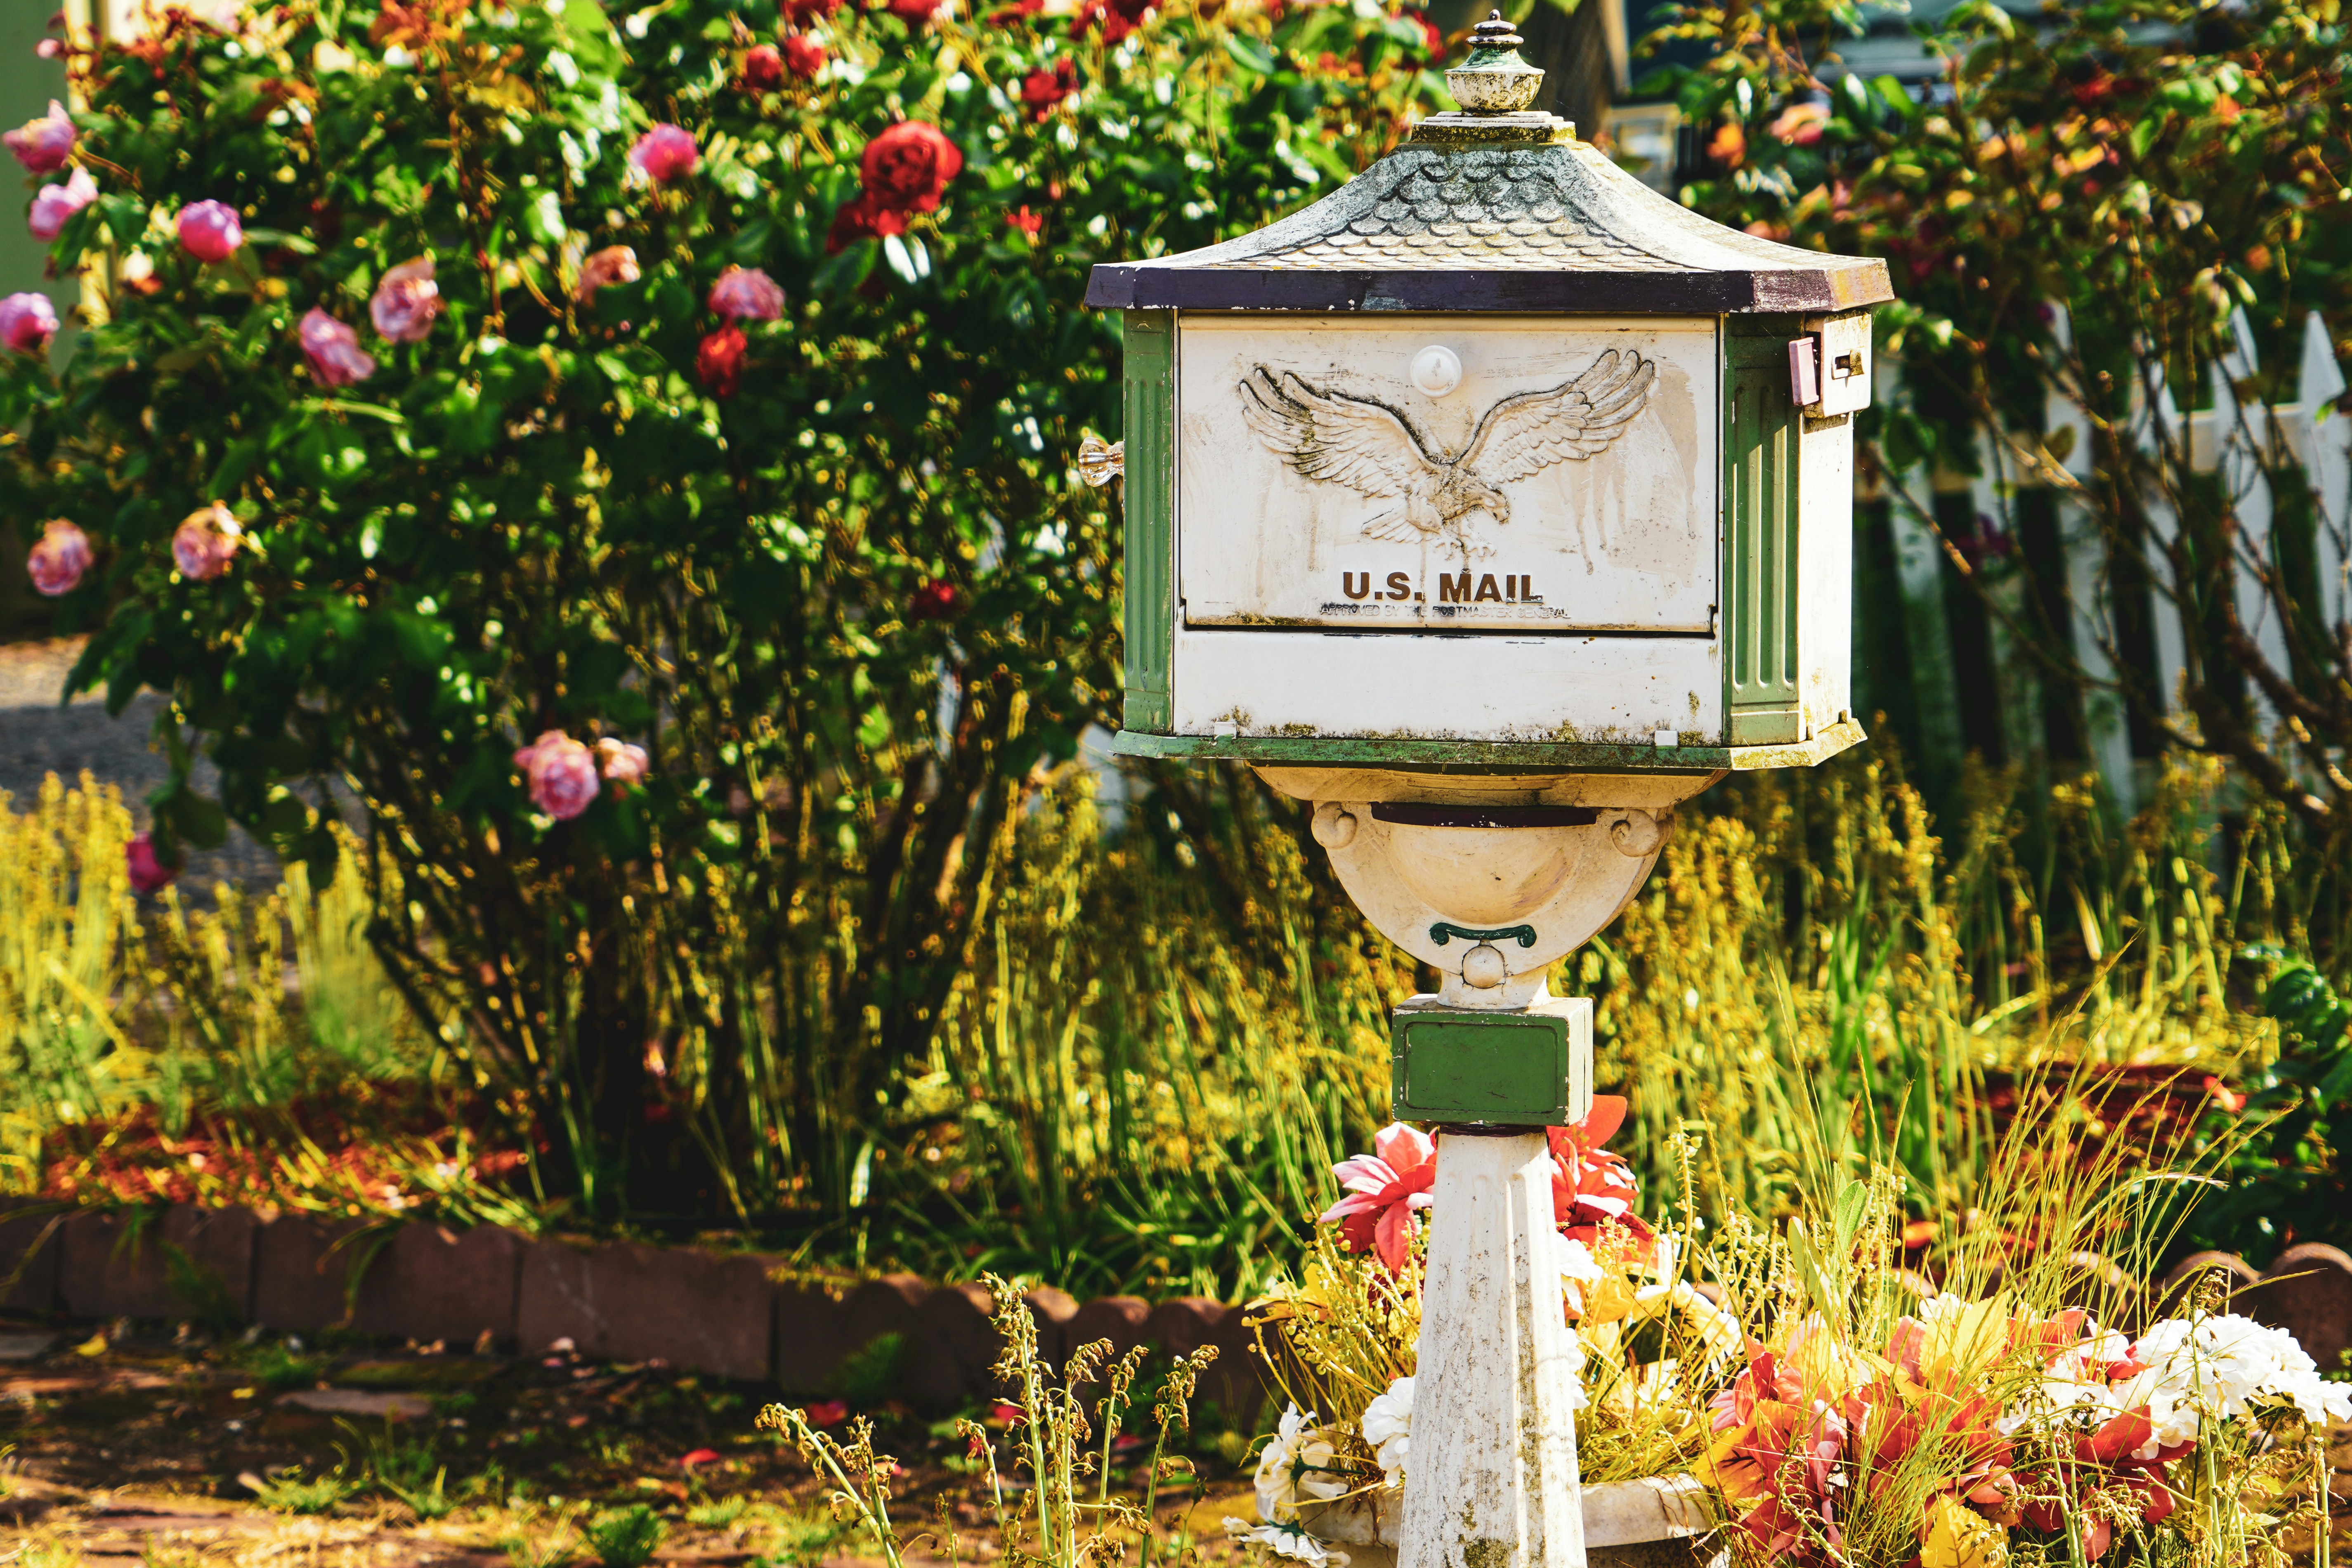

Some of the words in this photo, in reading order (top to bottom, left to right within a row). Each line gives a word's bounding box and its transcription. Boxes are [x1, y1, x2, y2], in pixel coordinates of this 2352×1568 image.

[1343, 572, 1423, 600] U.S.
[1439, 573, 1543, 604] MAIL
[1320, 604, 1380, 616] APPROVED
[1385, 605, 1400, 616] BY
[1405, 605, 1427, 616] THE
[1432, 605, 1511, 617] POSTMASTER
[1517, 607, 1571, 619] GENERAL
